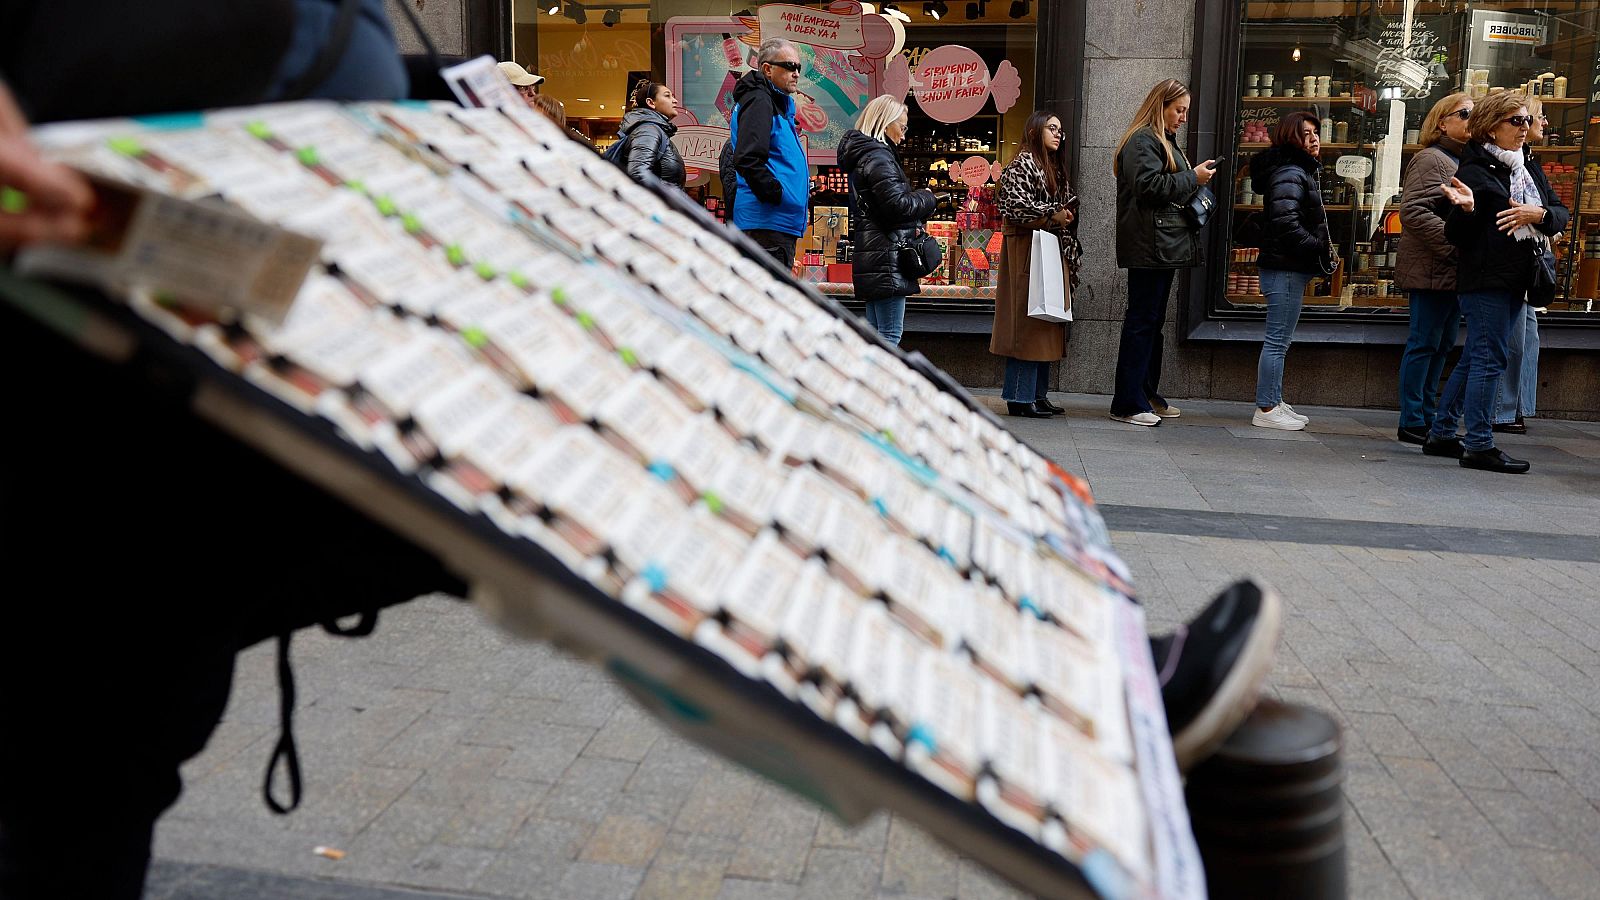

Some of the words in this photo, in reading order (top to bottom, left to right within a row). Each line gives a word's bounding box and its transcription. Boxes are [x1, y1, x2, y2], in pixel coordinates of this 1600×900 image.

[803, 15, 840, 29] EMPIEZA
[785, 23, 791, 31] A
[794, 24, 816, 35] OLER
[818, 29, 829, 38] YA
[830, 31, 837, 39] A
[924, 62, 978, 77] SIRVIENDO
[922, 90, 952, 102] SNOW
[956, 86, 985, 98] FAIRY
